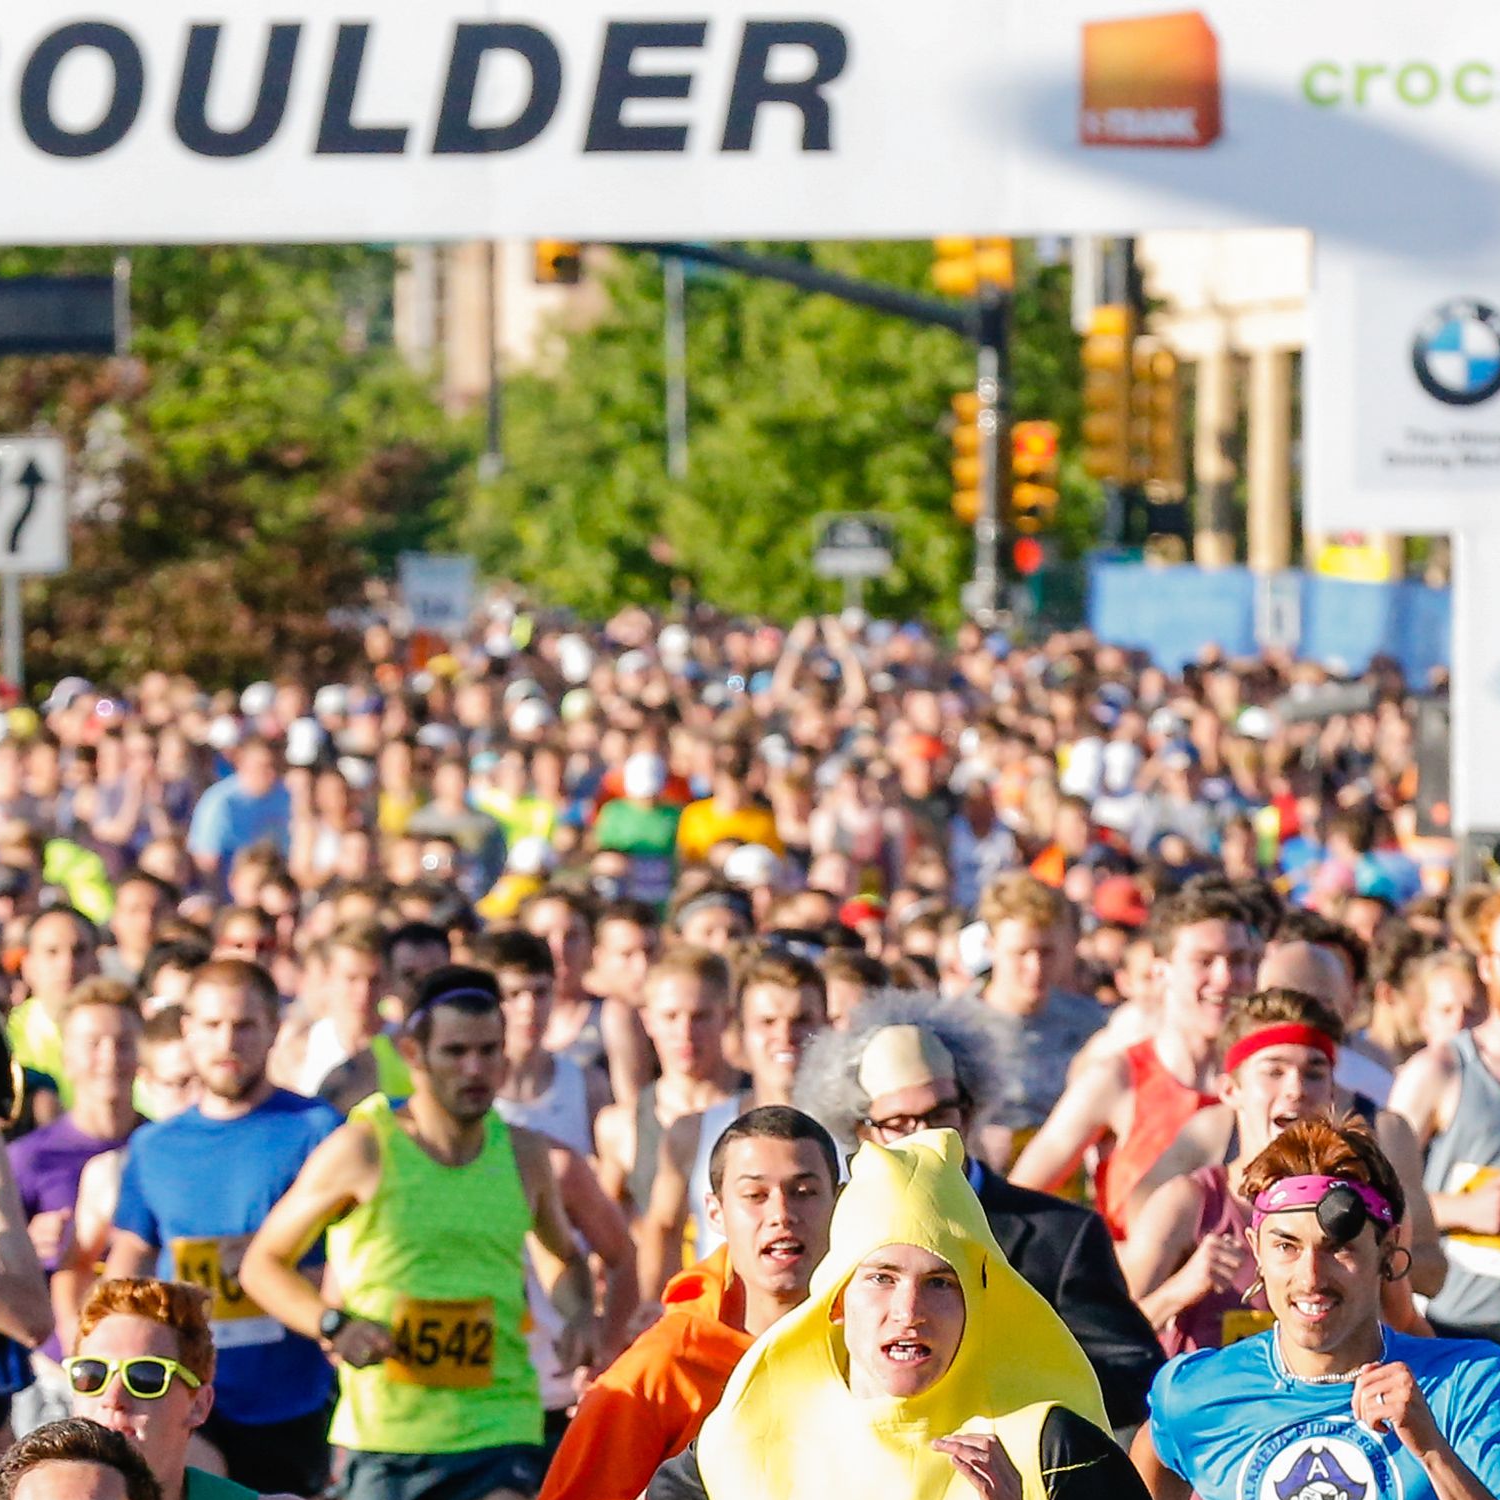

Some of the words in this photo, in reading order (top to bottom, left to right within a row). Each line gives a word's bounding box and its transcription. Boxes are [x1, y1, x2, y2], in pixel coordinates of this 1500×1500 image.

[395, 1319, 493, 1367] A542
[1296, 1423, 1354, 1440] MIDDLE
[1306, 1456, 1330, 1481] A
